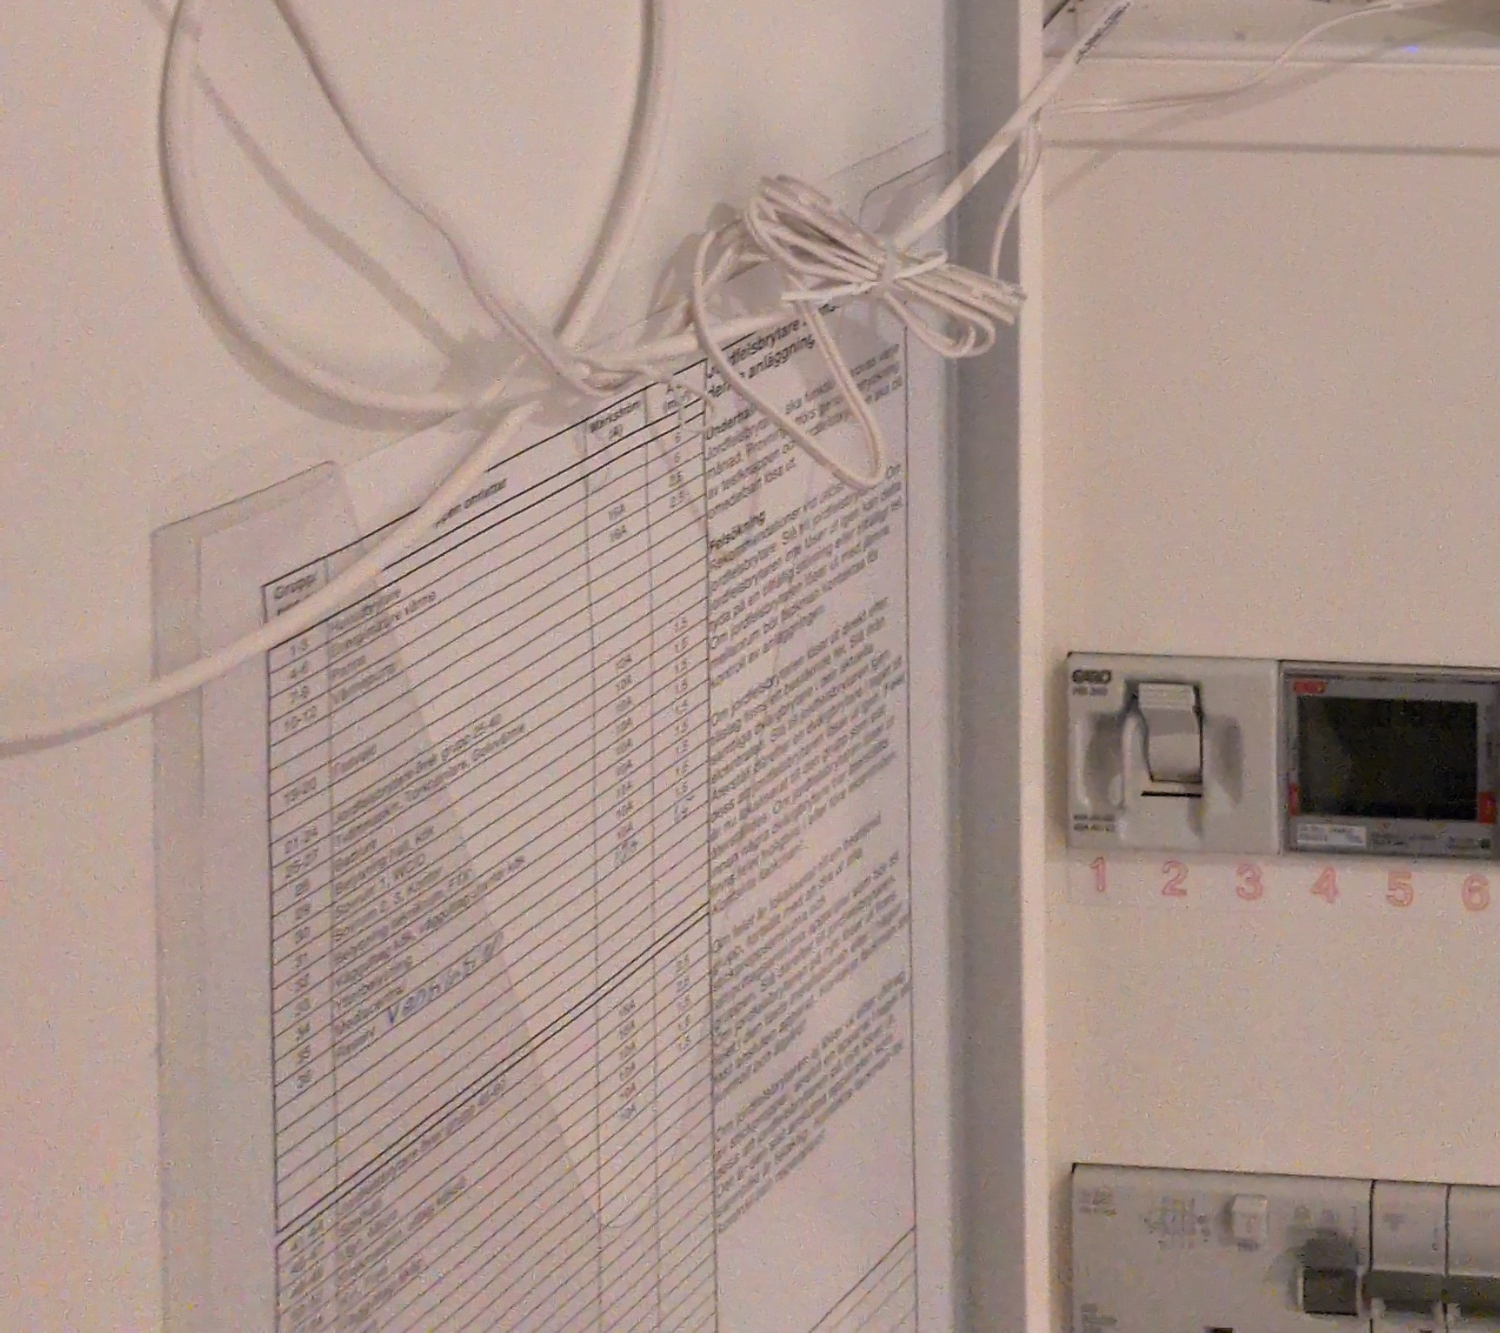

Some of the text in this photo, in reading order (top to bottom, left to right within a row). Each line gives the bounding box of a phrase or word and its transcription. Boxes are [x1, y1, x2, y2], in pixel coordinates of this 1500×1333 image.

[1089, 856, 1107, 893] 1
[1161, 860, 1189, 897] 2
[1235, 863, 1264, 901] 3
[1310, 866, 1340, 904] 4
[1386, 870, 1415, 908] 5
[1461, 874, 1490, 911] 6
